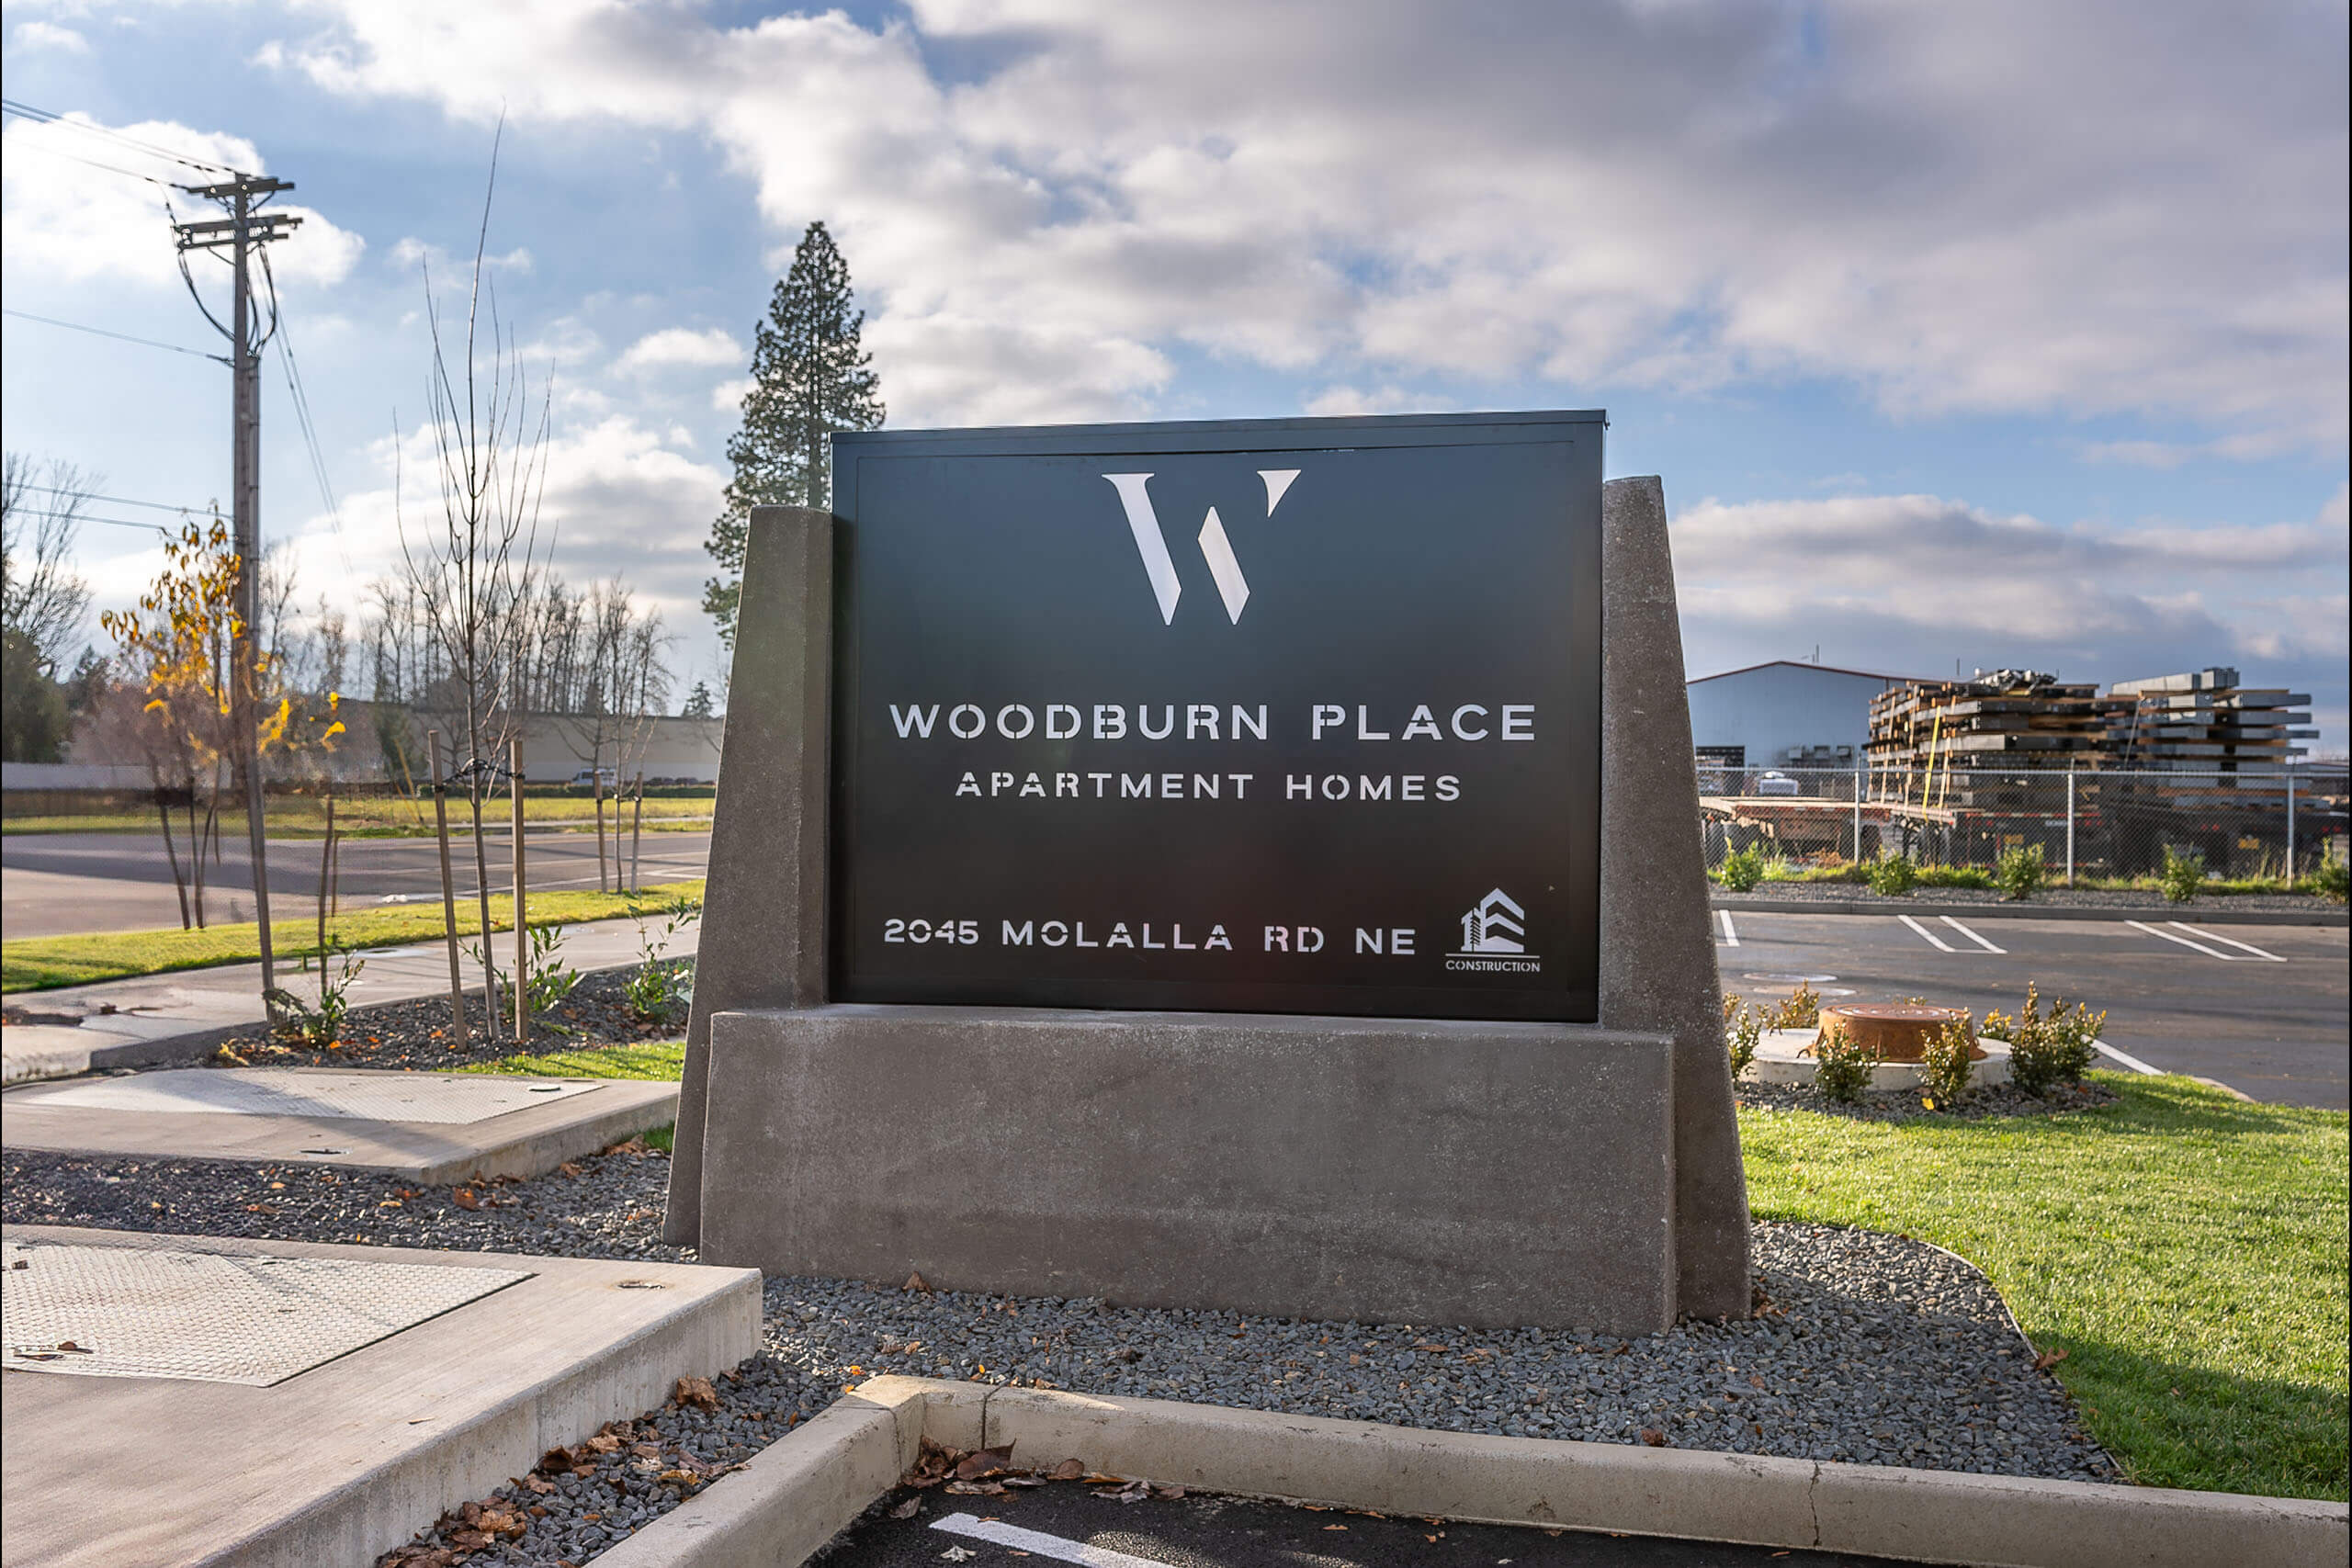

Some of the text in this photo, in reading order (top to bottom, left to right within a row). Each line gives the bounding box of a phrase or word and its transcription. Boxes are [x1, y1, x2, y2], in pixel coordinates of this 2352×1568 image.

[1102, 469, 1302, 626] W
[888, 703, 1536, 742] WOODBURN PLACE
[955, 772, 1461, 802] APARTMENT HOMES
[884, 919, 1417, 955] 2045 MOLALLA RD NE
[1445, 960, 1541, 973] CONSTRUCTION
